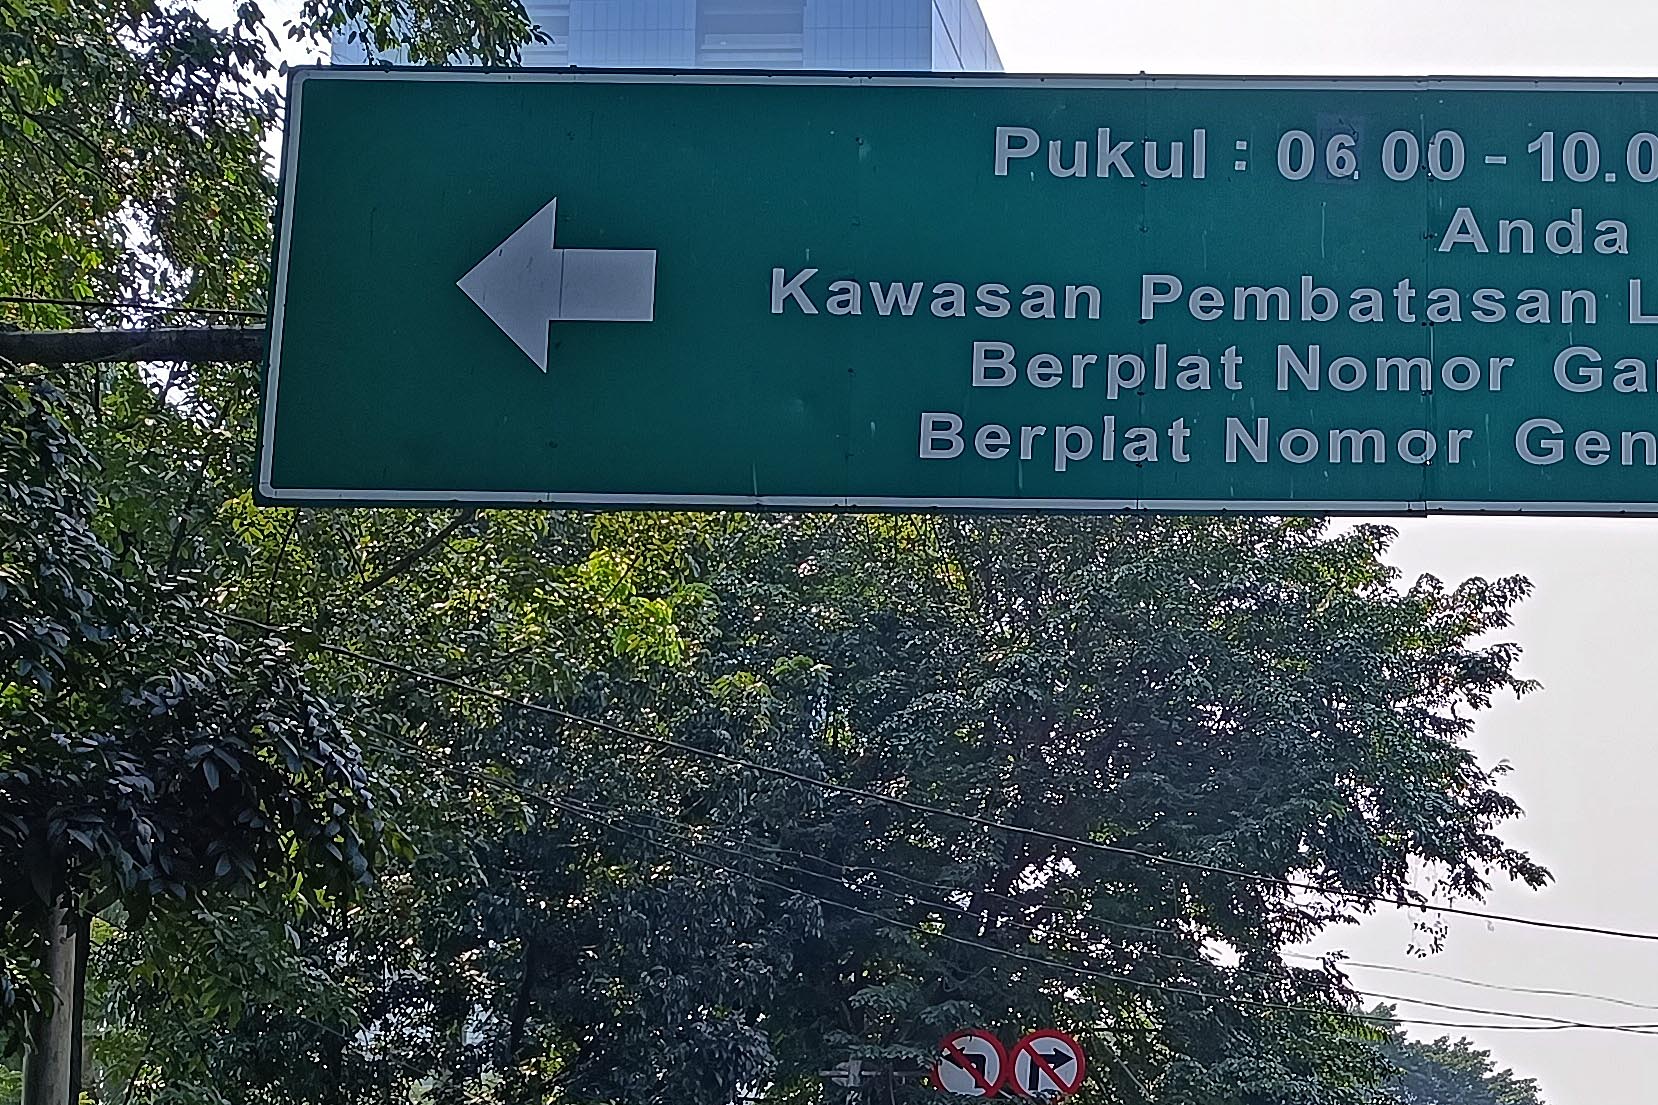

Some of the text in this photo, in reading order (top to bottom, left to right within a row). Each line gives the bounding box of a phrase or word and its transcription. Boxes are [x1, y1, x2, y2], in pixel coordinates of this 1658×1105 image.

[995, 127, 1205, 179] Pukul
[1439, 208, 1629, 255] Anda
[772, 268, 1101, 320] Kawasan
[1142, 275, 1597, 324] Pembatasan
[973, 342, 1243, 400] Berplat
[1278, 345, 1515, 393] Nomor
[920, 413, 1191, 472] Berplat
[1226, 418, 1474, 464] Nomor
